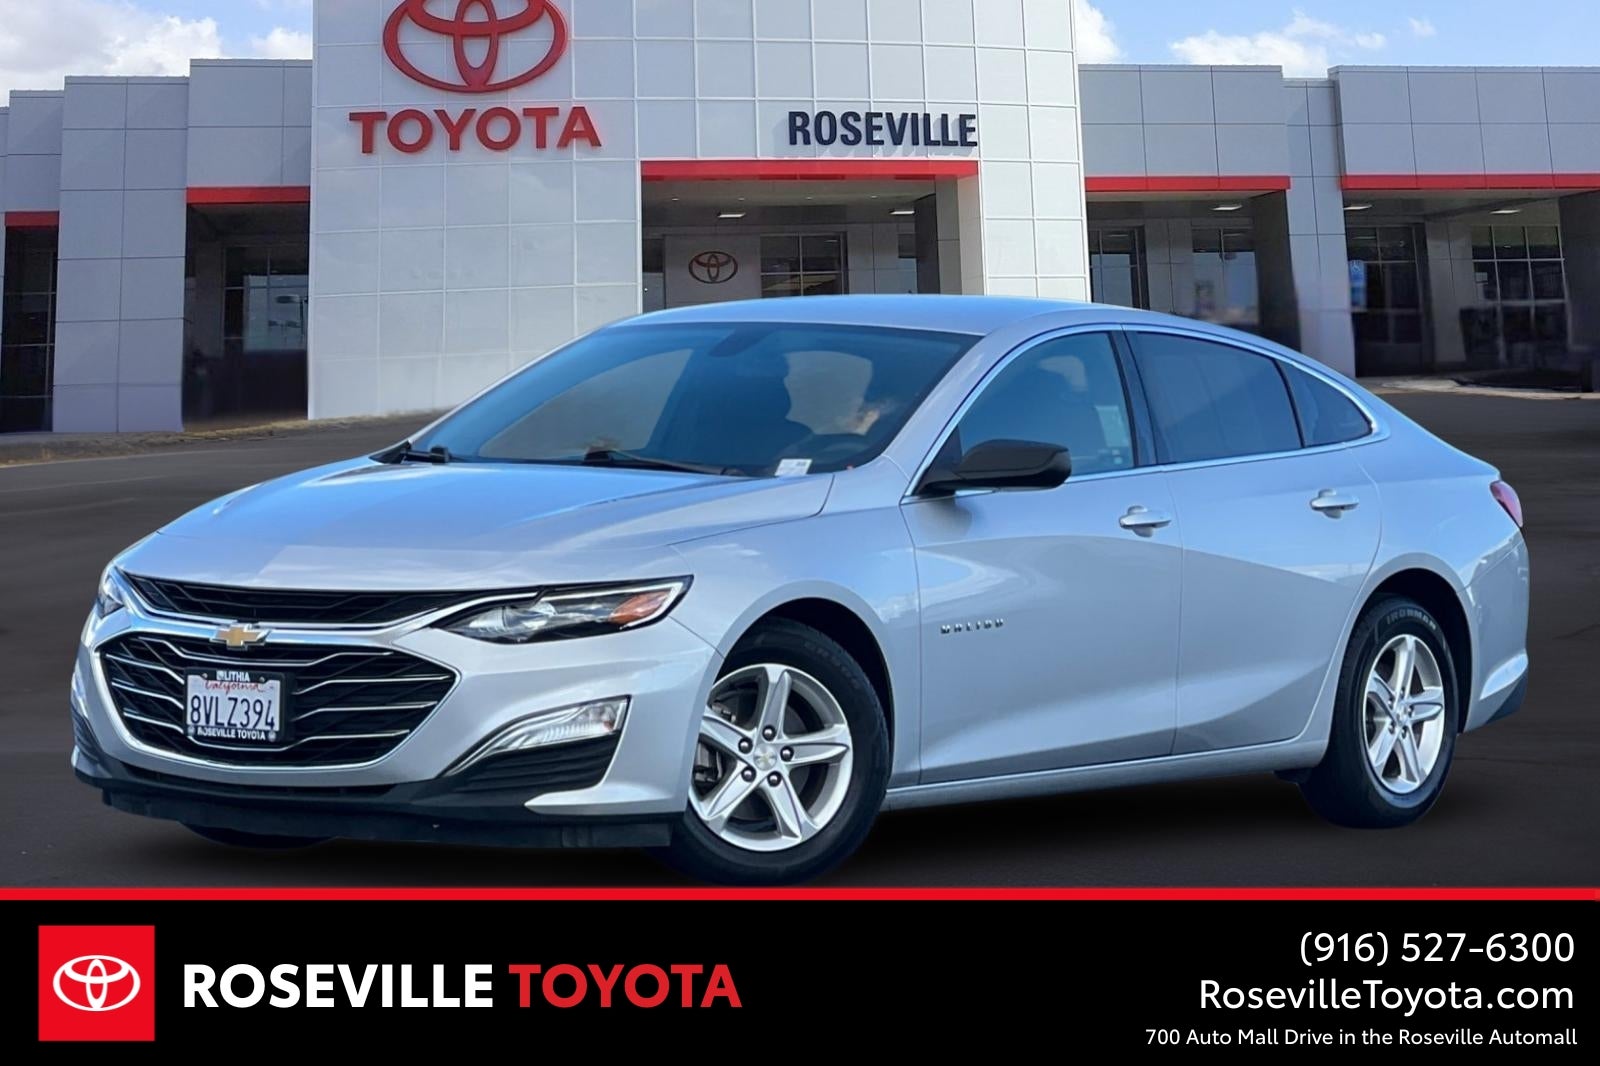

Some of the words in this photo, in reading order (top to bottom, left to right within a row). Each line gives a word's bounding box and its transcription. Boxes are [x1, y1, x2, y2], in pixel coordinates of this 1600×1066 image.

[349, 106, 602, 154] TOYOTA
[788, 110, 978, 147] ROSEVILLE
[190, 695, 275, 731] 8VLZ394
[197, 729, 236, 738] ROSEVILLE
[237, 731, 266, 740] TOYOTA
